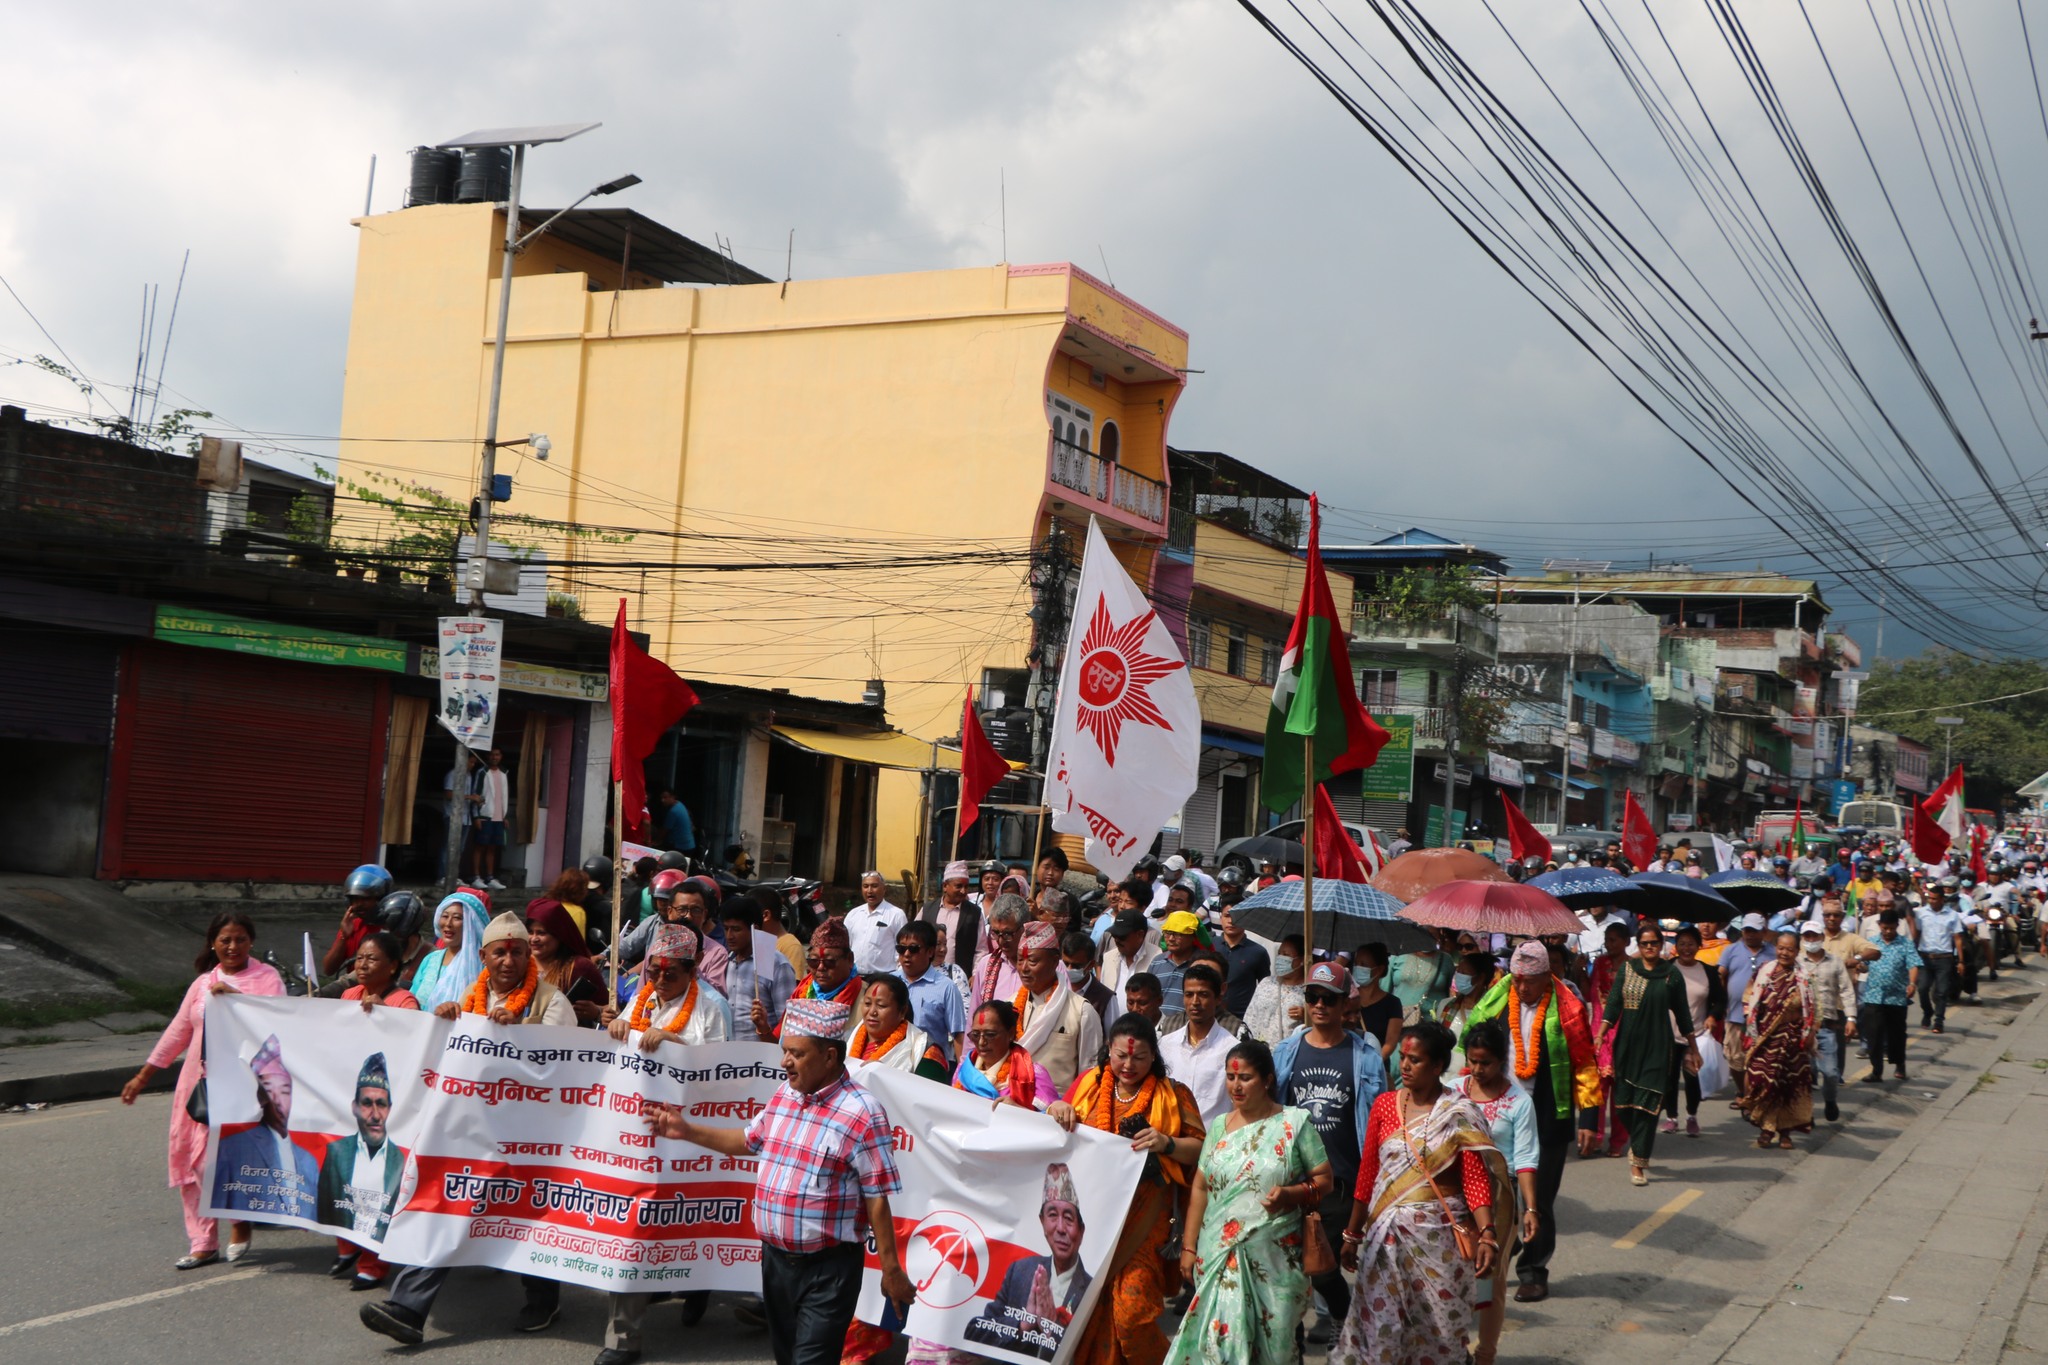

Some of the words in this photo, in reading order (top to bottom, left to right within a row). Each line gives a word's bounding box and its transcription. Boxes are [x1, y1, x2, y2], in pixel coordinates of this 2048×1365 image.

[446, 1035, 522, 1061] प्रतिनिधि
[527, 1049, 573, 1065] सभा
[577, 1050, 616, 1065] तथा
[620, 1053, 664, 1077] प्रदेश
[668, 1066, 711, 1083] सभा
[442, 1076, 553, 1106] कम्युनिष्ट
[560, 1083, 606, 1107] पार्टी
[619, 1131, 657, 1148] तथा
[240, 1164, 270, 1178] विजय
[497, 1141, 564, 1156] जनता
[570, 1145, 664, 1173] समाजवादी
[670, 1155, 714, 1172] पार्टी
[719, 1154, 760, 1173] नेपा
[444, 1166, 526, 1214] संयुक्त
[638, 1192, 747, 1227] मनोनयन
[470, 1218, 532, 1242] निर्वाचन
[533, 1226, 595, 1255] परिचालन
[597, 1237, 646, 1263] कमिटी
[647, 1241, 681, 1266] क्षेत्र
[717, 1244, 762, 1266] सुनस
[530, 1251, 558, 1267] २०७९
[563, 1256, 599, 1274] आश्विन
[601, 1266, 614, 1280] २३
[619, 1267, 639, 1280] गते
[643, 1266, 692, 1281] आईतवार
[1003, 1305, 1037, 1325] अशोक
[1040, 1316, 1065, 1338] कुमार
[1021, 1330, 1057, 1351] प्रतिनिधि
